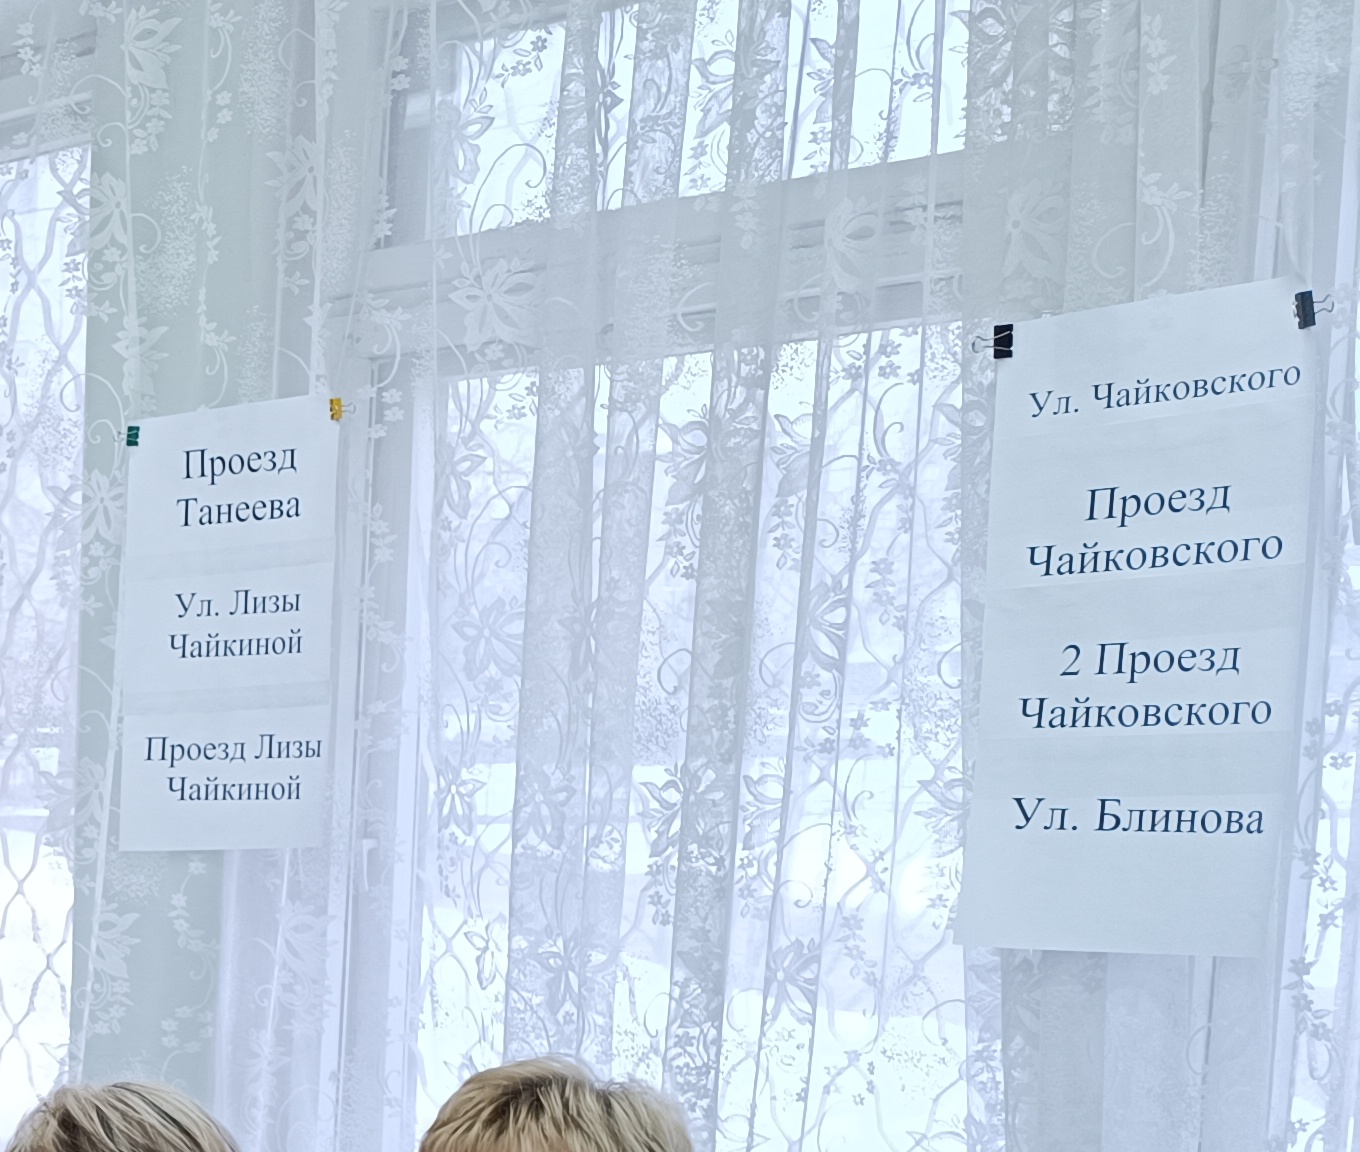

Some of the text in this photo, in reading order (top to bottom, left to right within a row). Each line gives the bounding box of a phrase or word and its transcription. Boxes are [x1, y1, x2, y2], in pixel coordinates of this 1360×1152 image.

[1029, 365, 1301, 418] Ул. Чайковского
[183, 447, 298, 486] Проезд
[176, 497, 301, 527] Танеева
[1084, 484, 1232, 528] Проезд
[1026, 531, 1284, 577] Чайковского
[175, 588, 301, 620] Ул. Лизы
[168, 628, 303, 660] Чайкиной
[1059, 641, 1242, 685] 2 Проезд
[1020, 696, 1272, 730] Чайковского
[144, 732, 323, 769] Проезд Лизы
[167, 774, 302, 802] Чайкиной
[1011, 796, 1265, 836] Ул. Блинова
